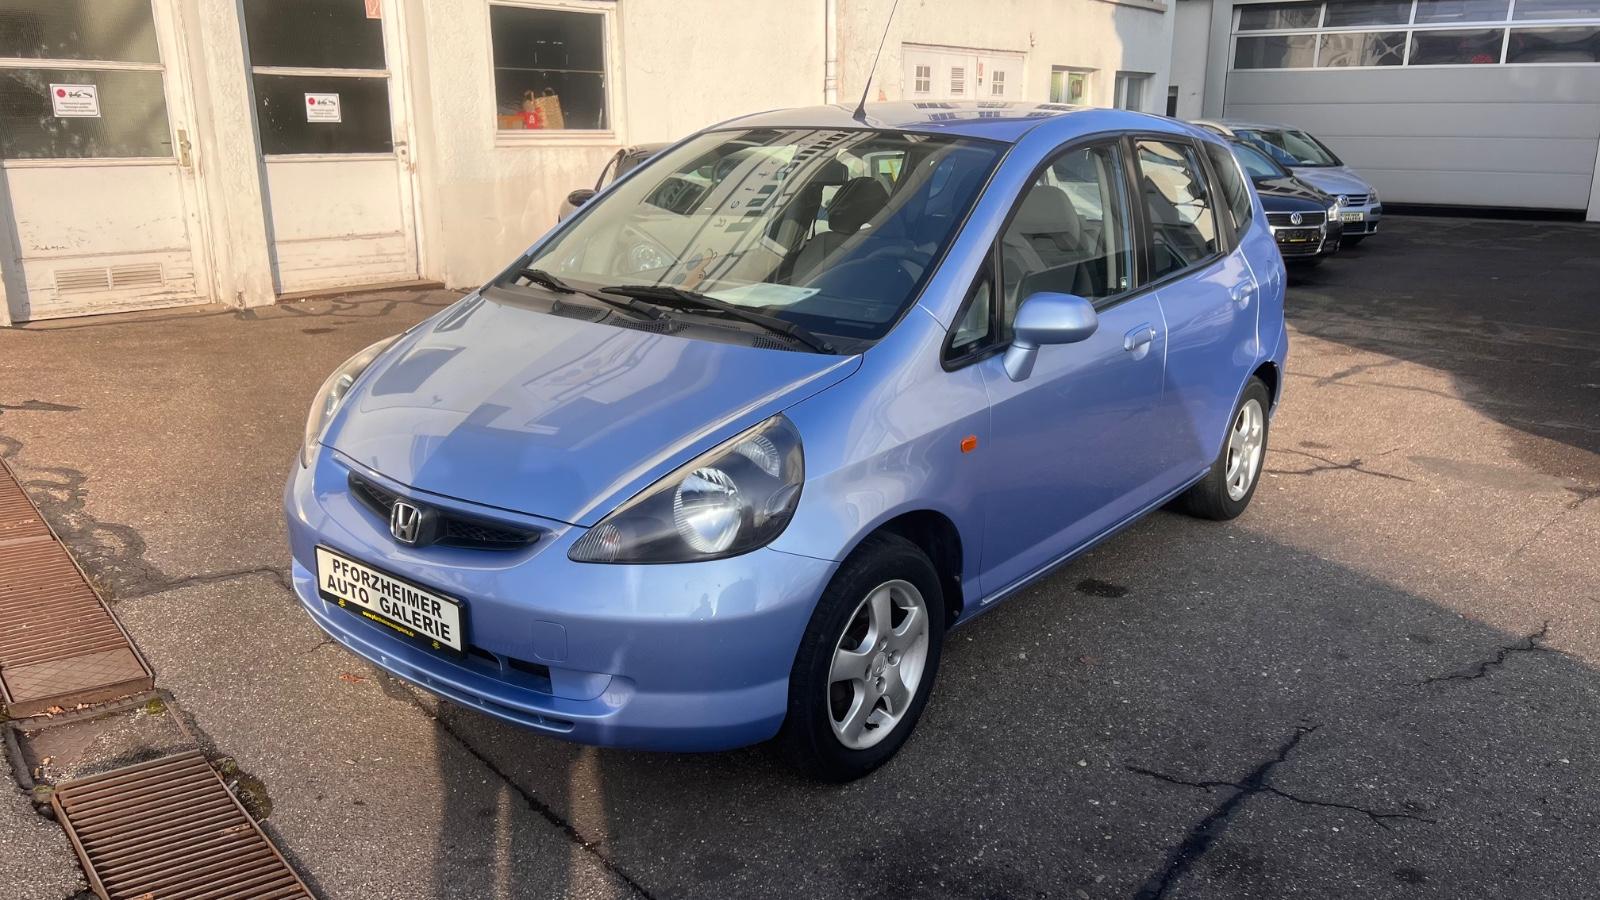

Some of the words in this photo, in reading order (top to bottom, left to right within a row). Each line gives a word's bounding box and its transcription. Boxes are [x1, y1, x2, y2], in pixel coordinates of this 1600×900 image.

[327, 574, 370, 604] AUTO
[379, 596, 452, 643] GALERIE
[332, 558, 442, 619] PFORZHEIMER
